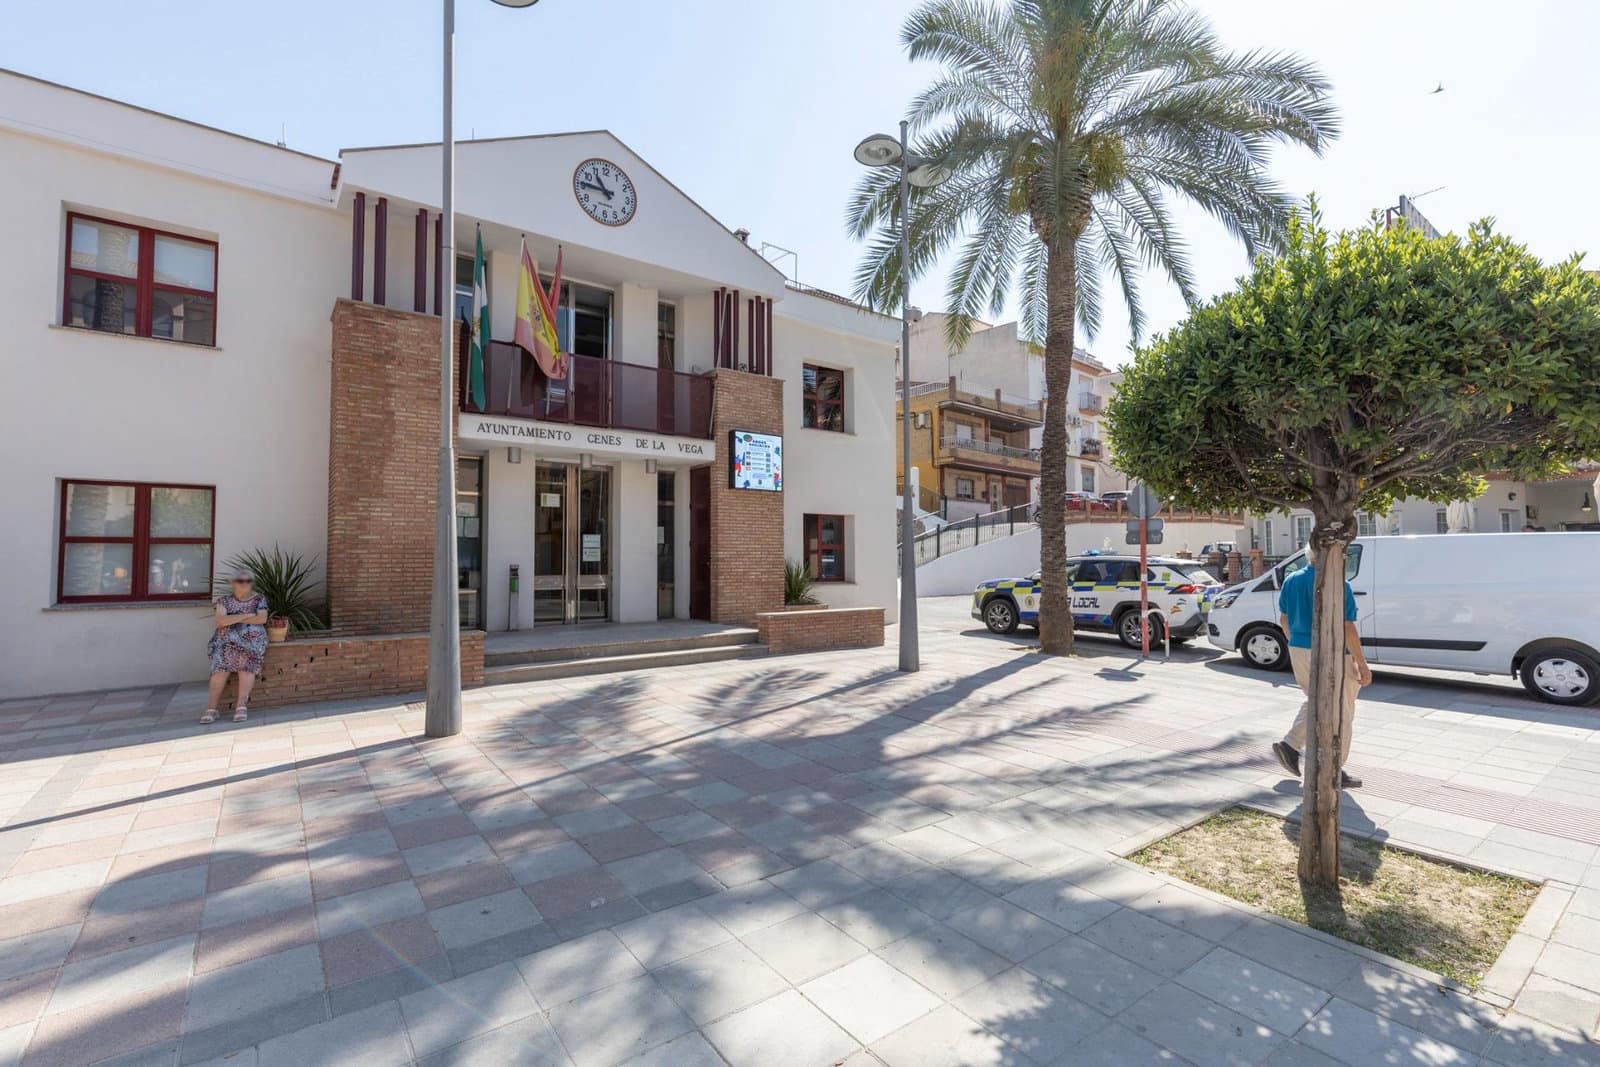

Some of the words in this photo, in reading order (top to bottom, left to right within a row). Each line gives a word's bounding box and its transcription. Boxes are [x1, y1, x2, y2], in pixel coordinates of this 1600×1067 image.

[593, 167, 599, 176] 11
[602, 167, 610, 176] 12
[585, 172, 593, 182] 10
[622, 184, 628, 192] 2
[584, 194, 590, 202] 8
[624, 196, 630, 206] 3
[592, 204, 598, 212] 7
[602, 210, 608, 218] 6
[612, 211, 618, 220] 5
[477, 422, 572, 441] AYUNTAMIENTO
[587, 434, 622, 446] CENES
[636, 439, 648, 448] DE
[653, 440, 665, 451] LA
[678, 443, 704, 454] VEGA
[1072, 597, 1100, 608] LOCAL
